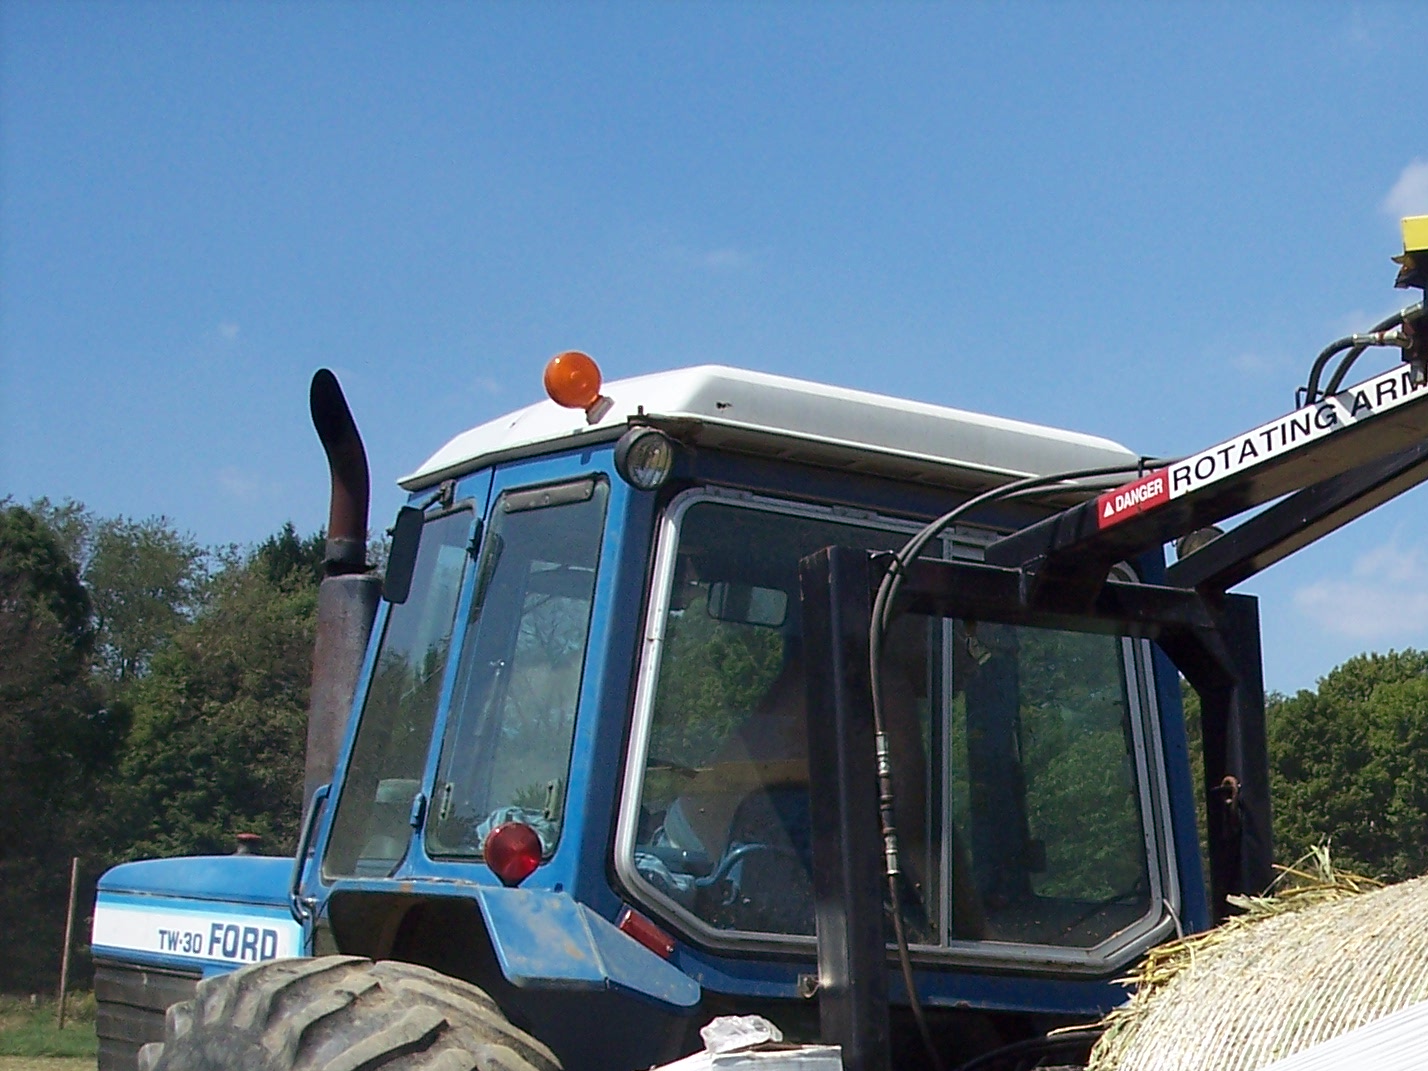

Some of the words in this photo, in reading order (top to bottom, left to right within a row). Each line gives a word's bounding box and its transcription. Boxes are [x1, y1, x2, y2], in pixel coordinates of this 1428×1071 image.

[1115, 478, 1163, 514] DANGER
[1173, 404, 1338, 491] ROTATING
[1351, 371, 1428, 417] ARM
[208, 923, 278, 961] FORD
